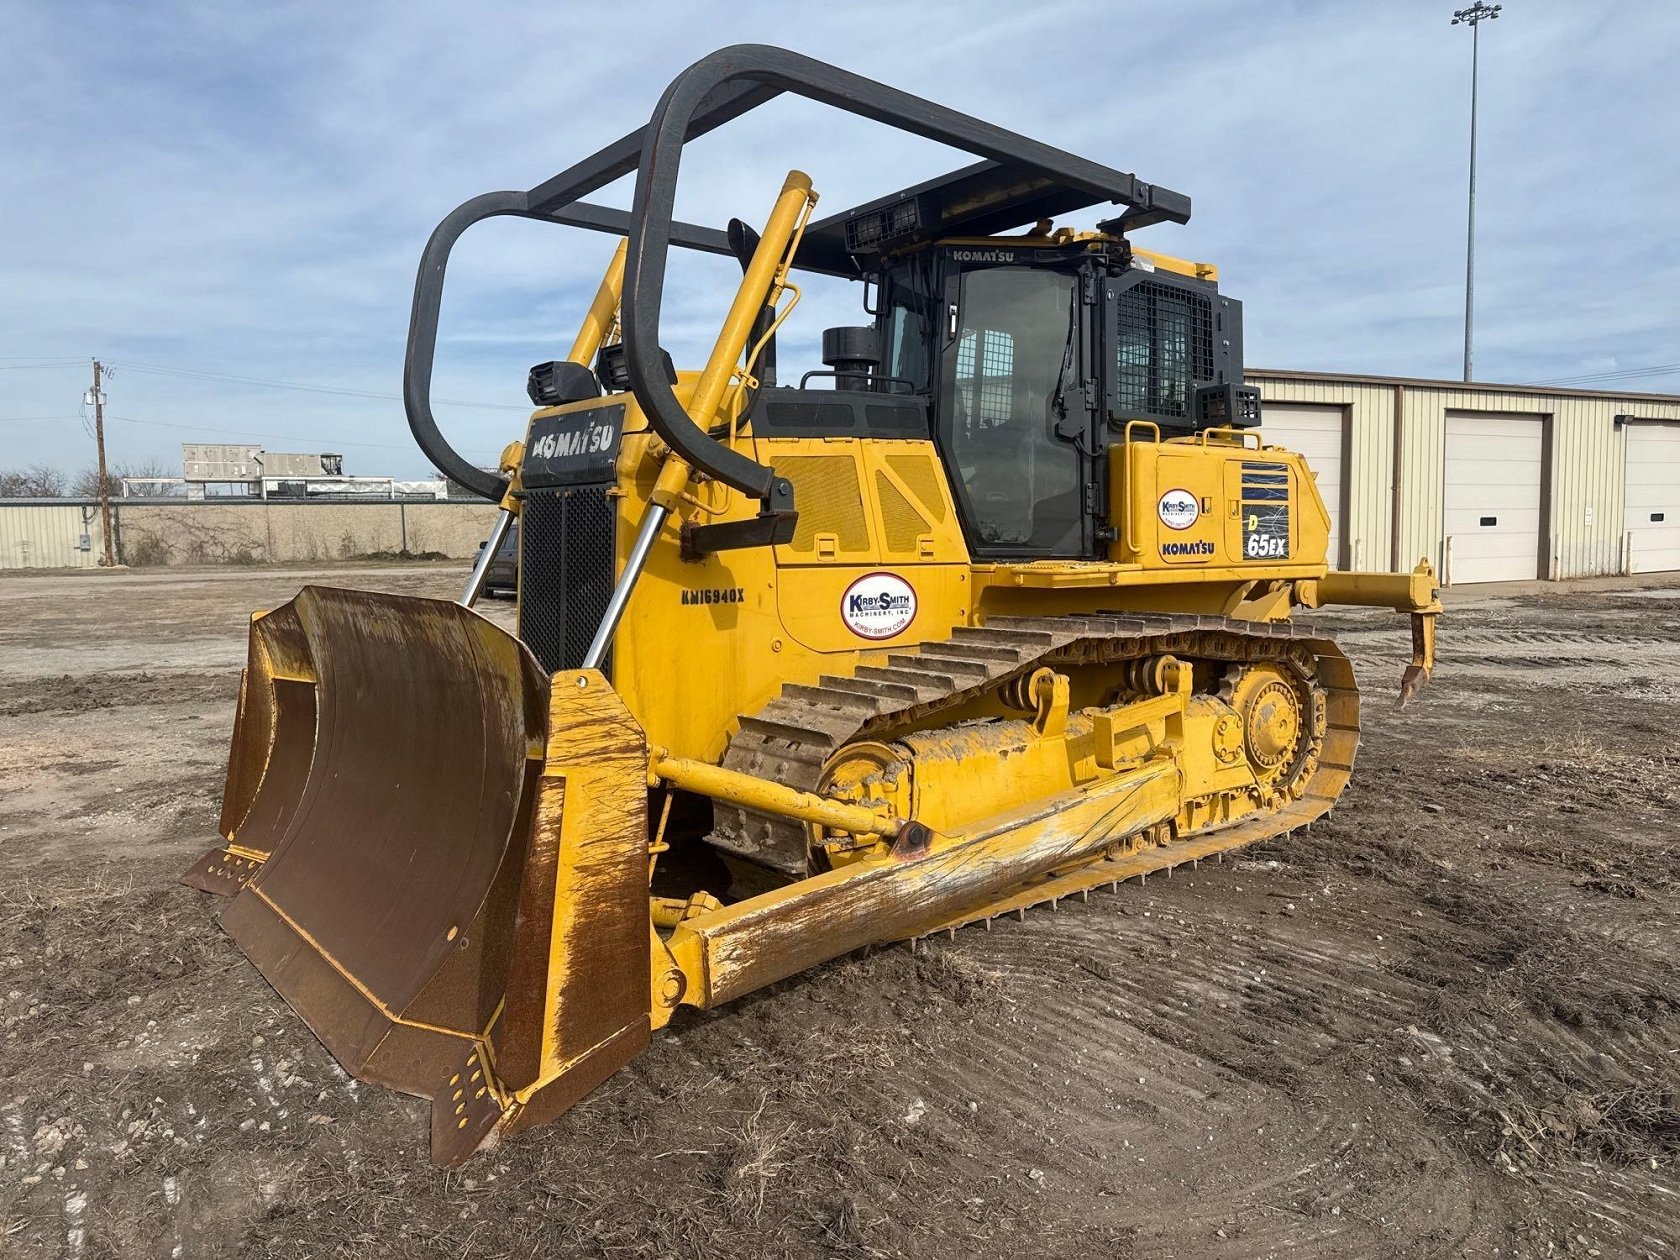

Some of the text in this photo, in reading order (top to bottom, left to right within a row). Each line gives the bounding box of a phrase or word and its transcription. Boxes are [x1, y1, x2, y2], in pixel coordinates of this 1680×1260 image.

[953, 249, 1014, 262] KOMATSU
[532, 421, 615, 459] KOMATSU
[1248, 514, 1258, 531] D
[1162, 539, 1215, 555] KOMATSU
[1247, 533, 1286, 556] 65EX
[849, 592, 910, 612] KIRBY-SMITH
[854, 618, 906, 634] KIRBY-SMITH.COM
